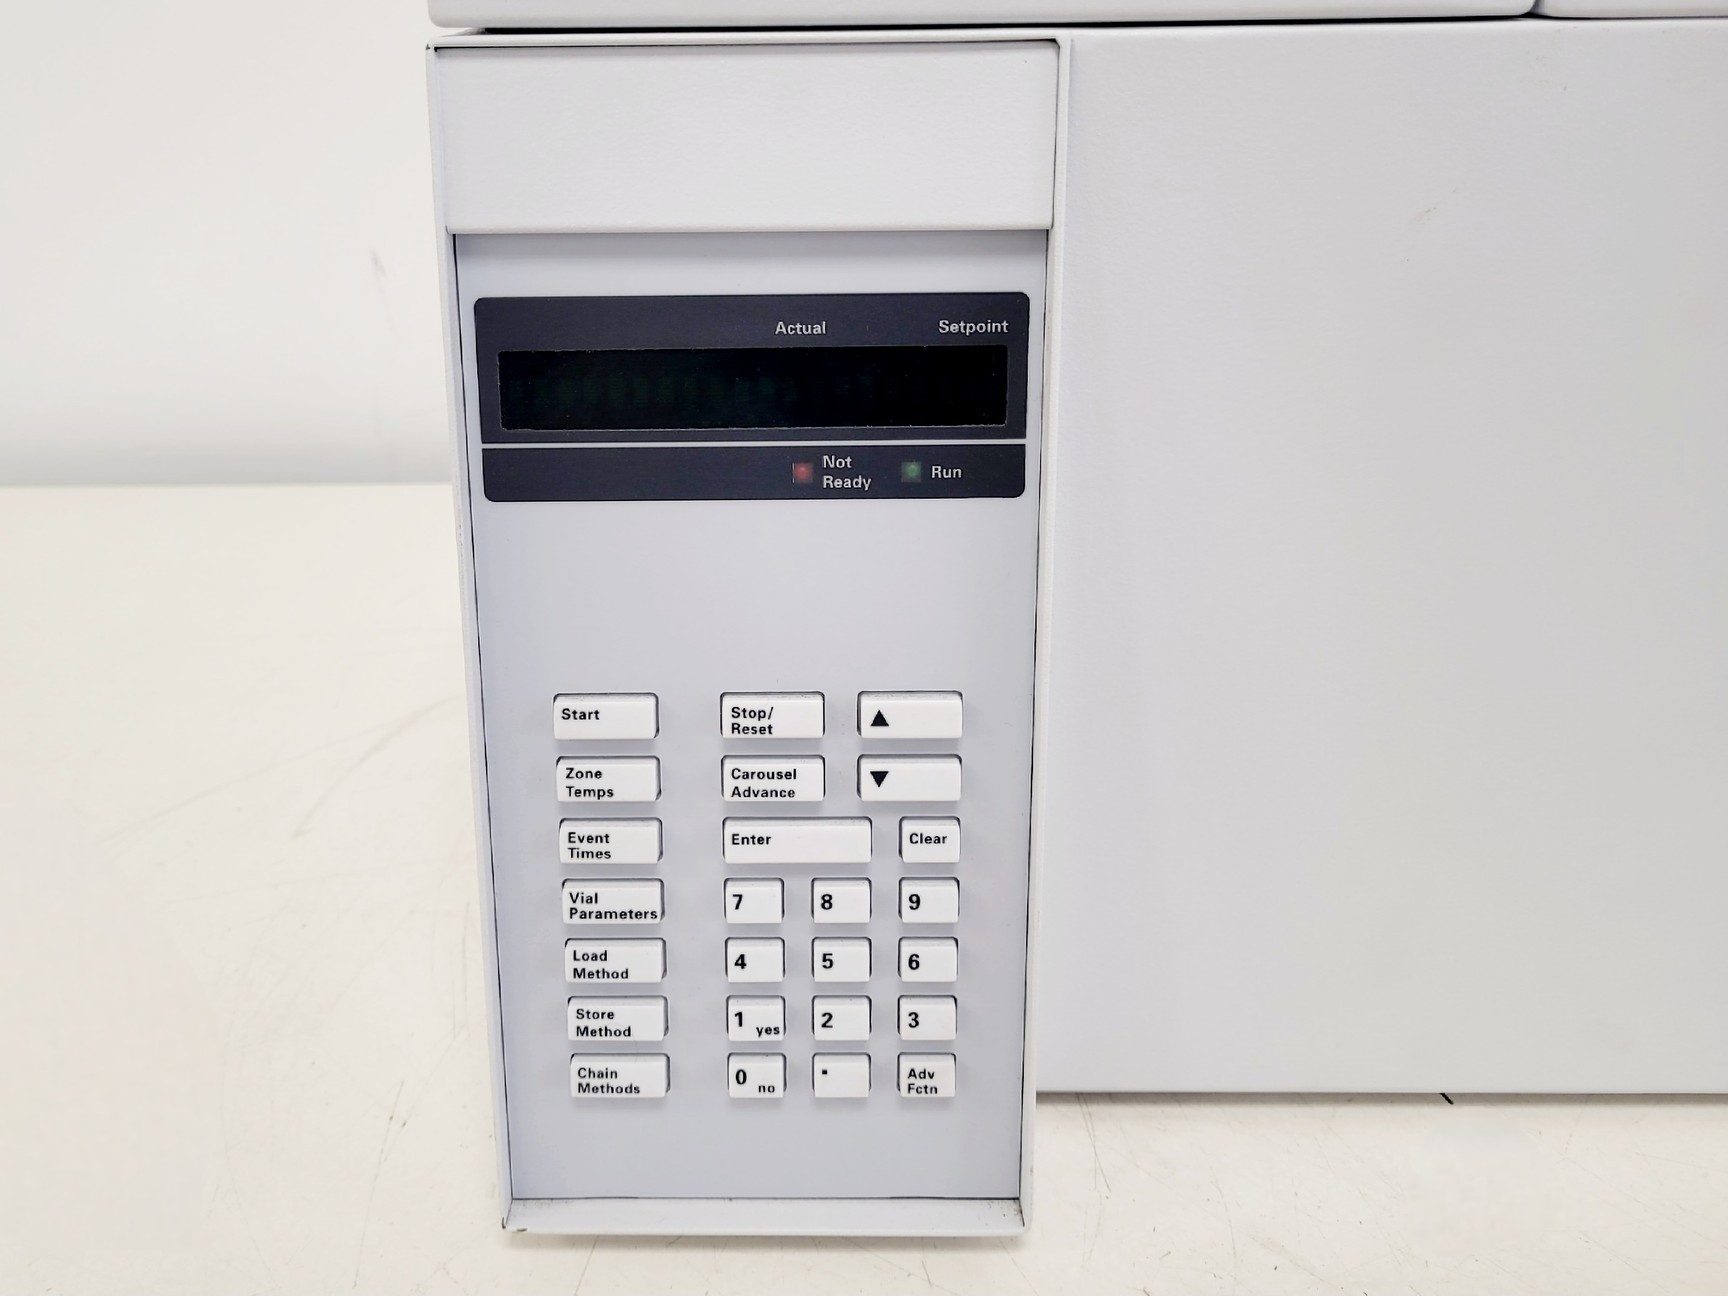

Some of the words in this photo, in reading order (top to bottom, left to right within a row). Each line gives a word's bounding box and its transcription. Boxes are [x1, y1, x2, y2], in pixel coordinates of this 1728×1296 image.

[775, 321, 826, 335] Actual
[938, 319, 1009, 336] Setpoint
[822, 455, 852, 469] Not
[931, 465, 962, 479] Run
[823, 475, 872, 491] Ready
[561, 707, 600, 721] Start
[731, 706, 774, 722] Stop/
[731, 722, 774, 735] Reset
[565, 767, 603, 780] Zone
[731, 767, 797, 780] Carousel
[565, 785, 614, 801] Temps
[730, 785, 796, 798] Advance
[567, 831, 610, 844] Event
[731, 833, 772, 846] Enter
[909, 832, 948, 845] Clear
[567, 847, 612, 860] Times
[569, 892, 599, 905] Vial
[732, 893, 743, 910] 7
[820, 893, 833, 911] 8
[908, 893, 921, 911] 9
[569, 907, 658, 920] Parameters
[573, 949, 608, 962] Load
[734, 953, 747, 970] 4
[822, 952, 834, 970] 5
[907, 953, 920, 971] 6
[573, 967, 629, 980] Method
[576, 1008, 615, 1020] Store
[821, 1012, 834, 1029] 2
[908, 1011, 920, 1029] 3
[576, 1025, 632, 1037] Method
[734, 1011, 743, 1028] 1
[755, 1026, 780, 1038] yes
[577, 1067, 618, 1079] Chain
[907, 1068, 935, 1080] Adv
[735, 1068, 747, 1086] 0
[758, 1085, 776, 1093] no
[577, 1082, 641, 1094] Methods
[907, 1082, 938, 1095] Fctn
